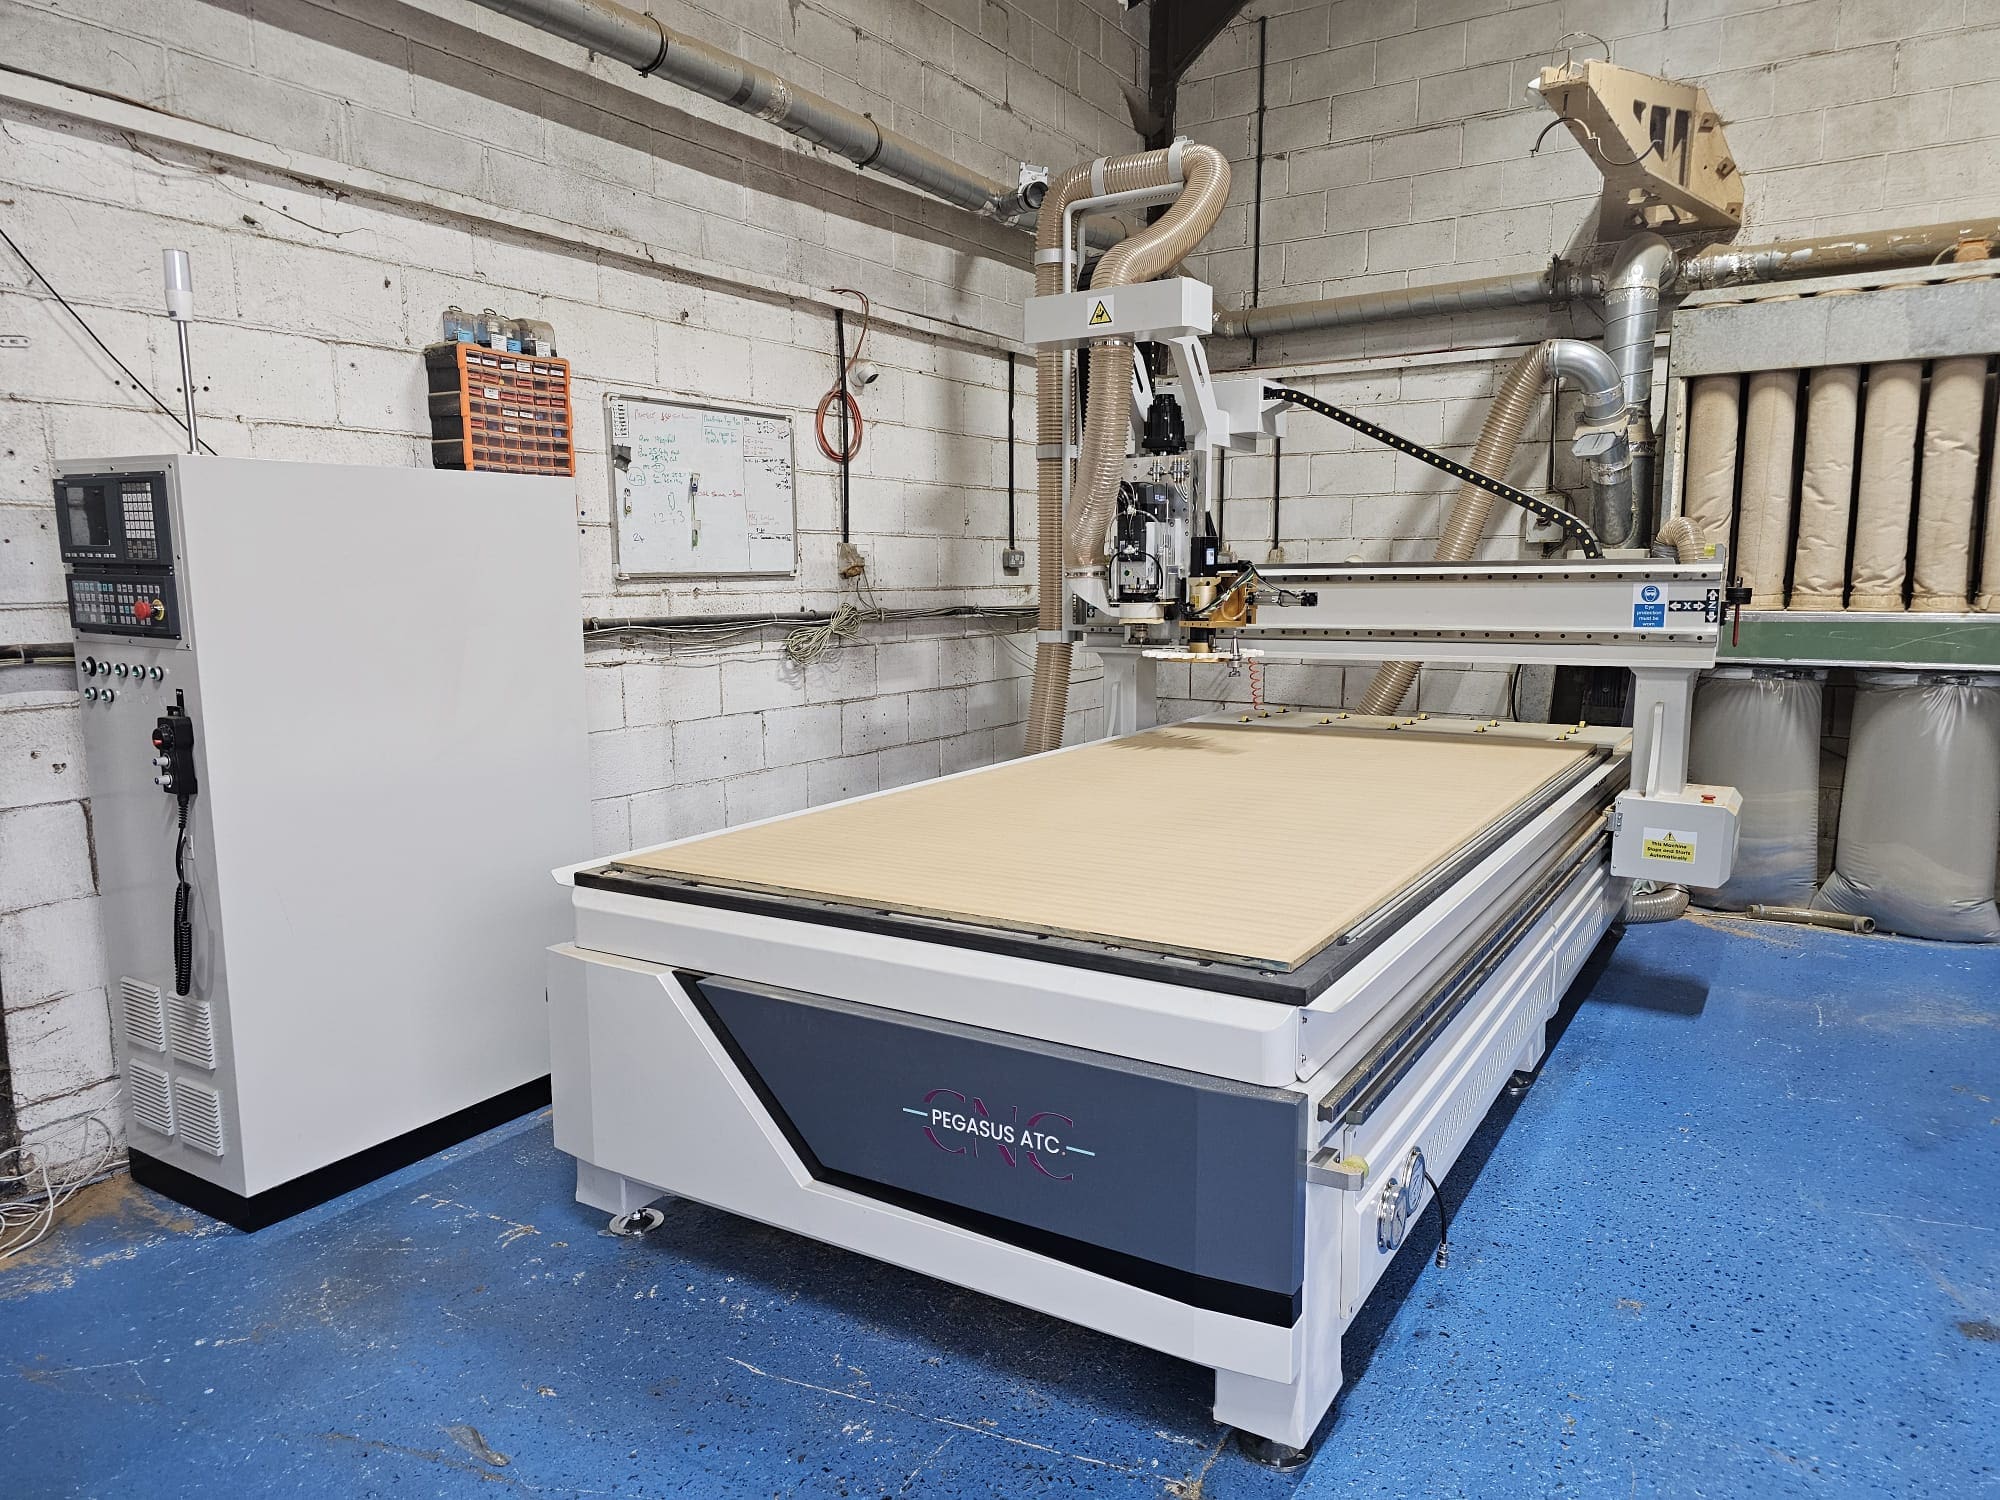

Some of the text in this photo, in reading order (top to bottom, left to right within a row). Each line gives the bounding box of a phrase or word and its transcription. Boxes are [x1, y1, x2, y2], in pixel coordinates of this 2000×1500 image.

[1683, 602, 1692, 610] X
[1649, 852, 1687, 861] Automatically
[932, 1108, 1014, 1143] PEGASUS
